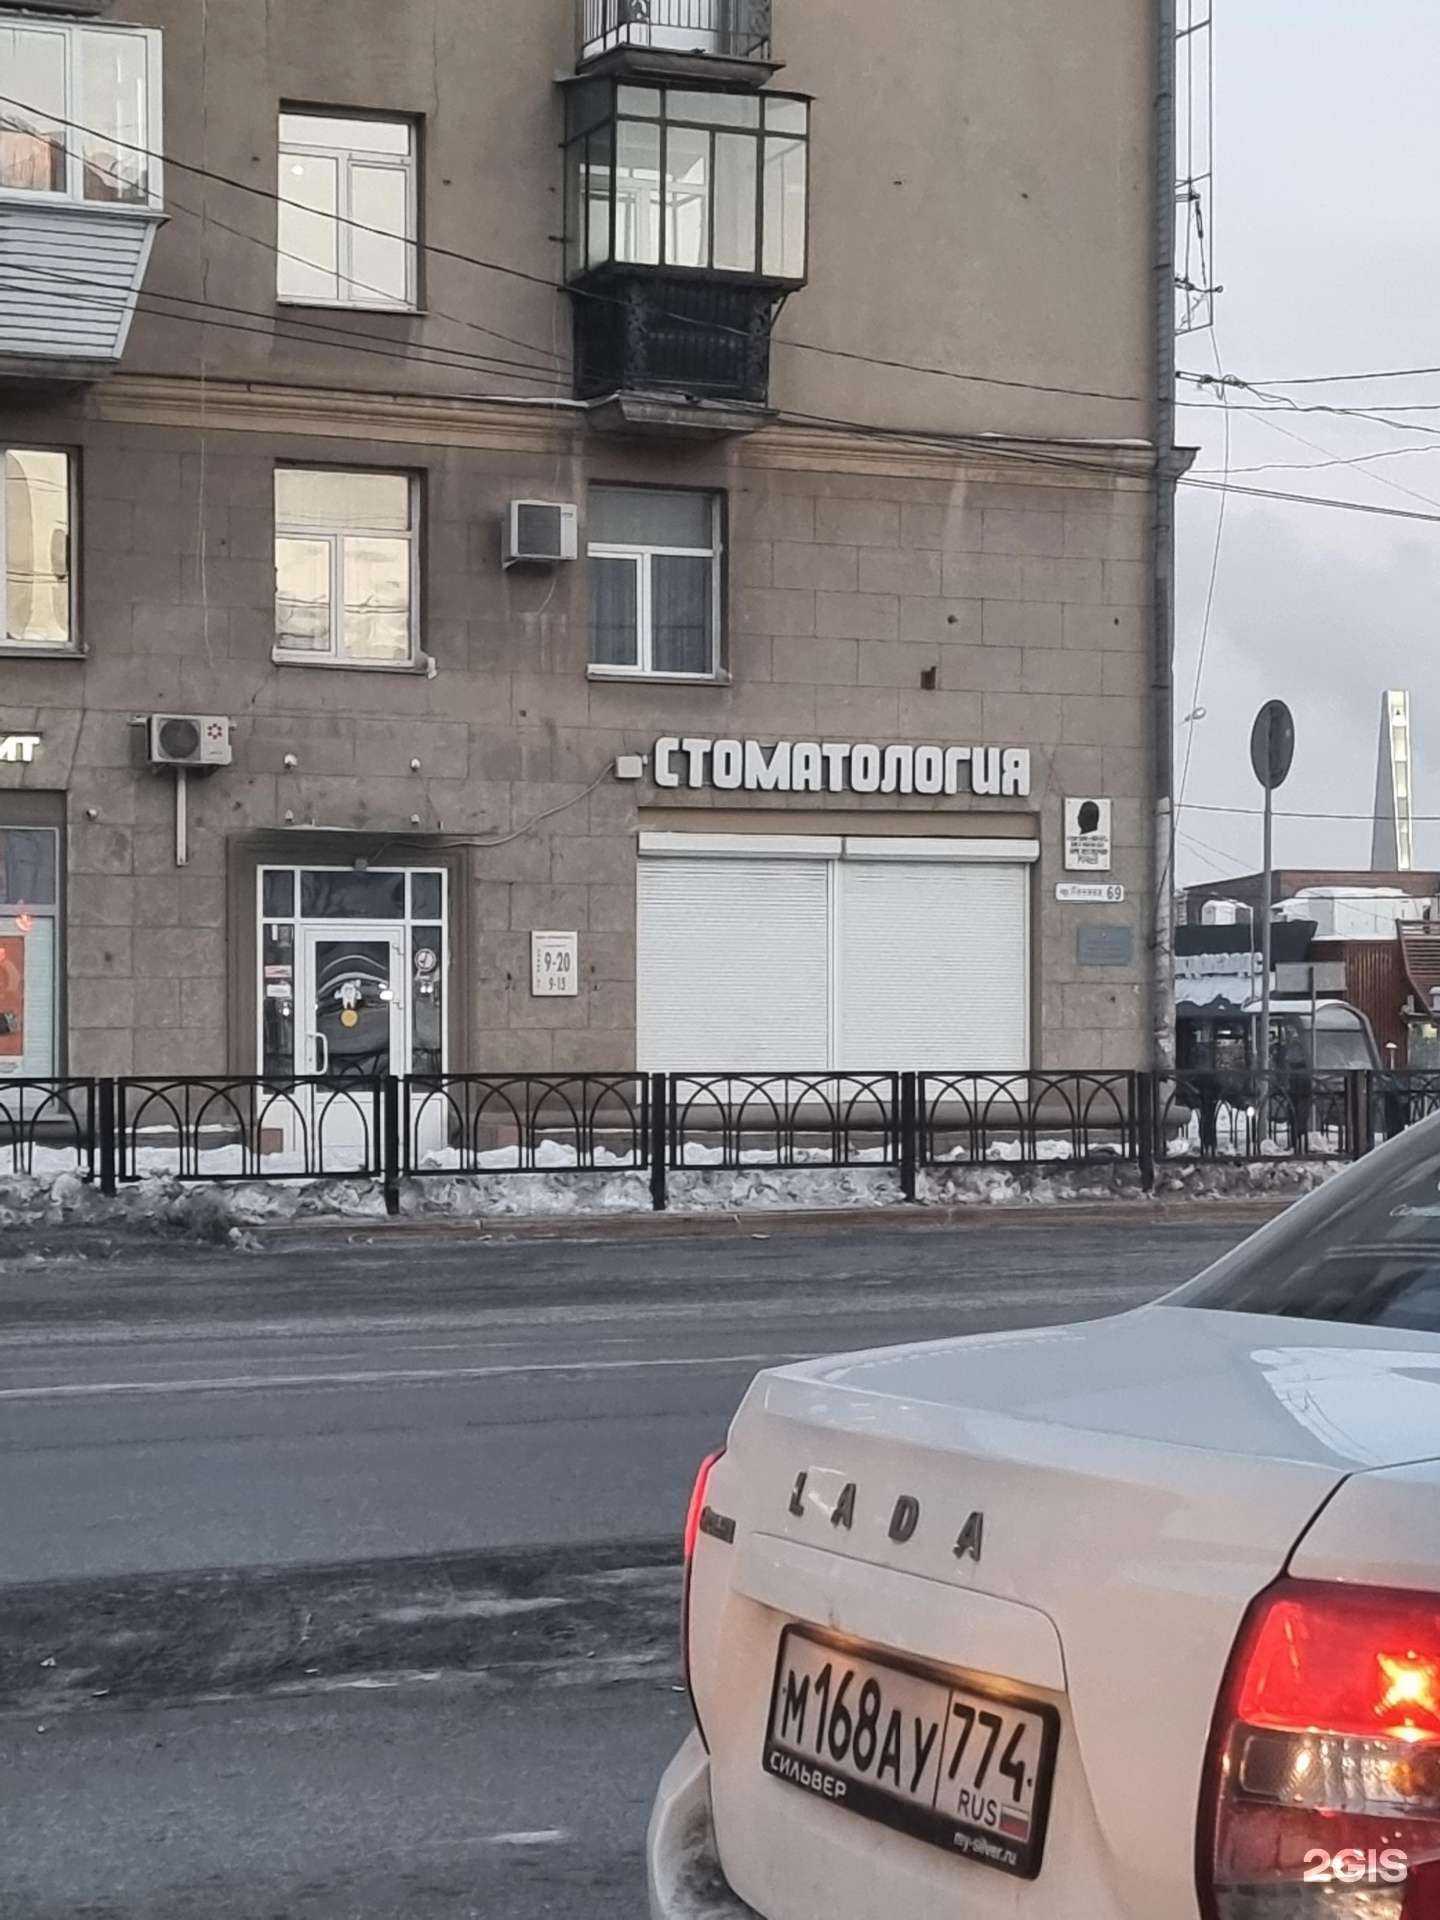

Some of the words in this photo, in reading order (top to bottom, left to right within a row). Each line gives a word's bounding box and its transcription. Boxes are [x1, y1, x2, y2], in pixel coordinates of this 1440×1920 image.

[654, 736, 1031, 796] СТОМАТОЛОГИЯ
[1106, 886, 1122, 900] 69
[544, 951, 571, 972] 9-20
[788, 1471, 984, 1562] LADA
[769, 1751, 848, 1799] СИЛЬВЕР
[948, 1702, 1027, 1802] 774
[957, 1788, 998, 1827] RUS
